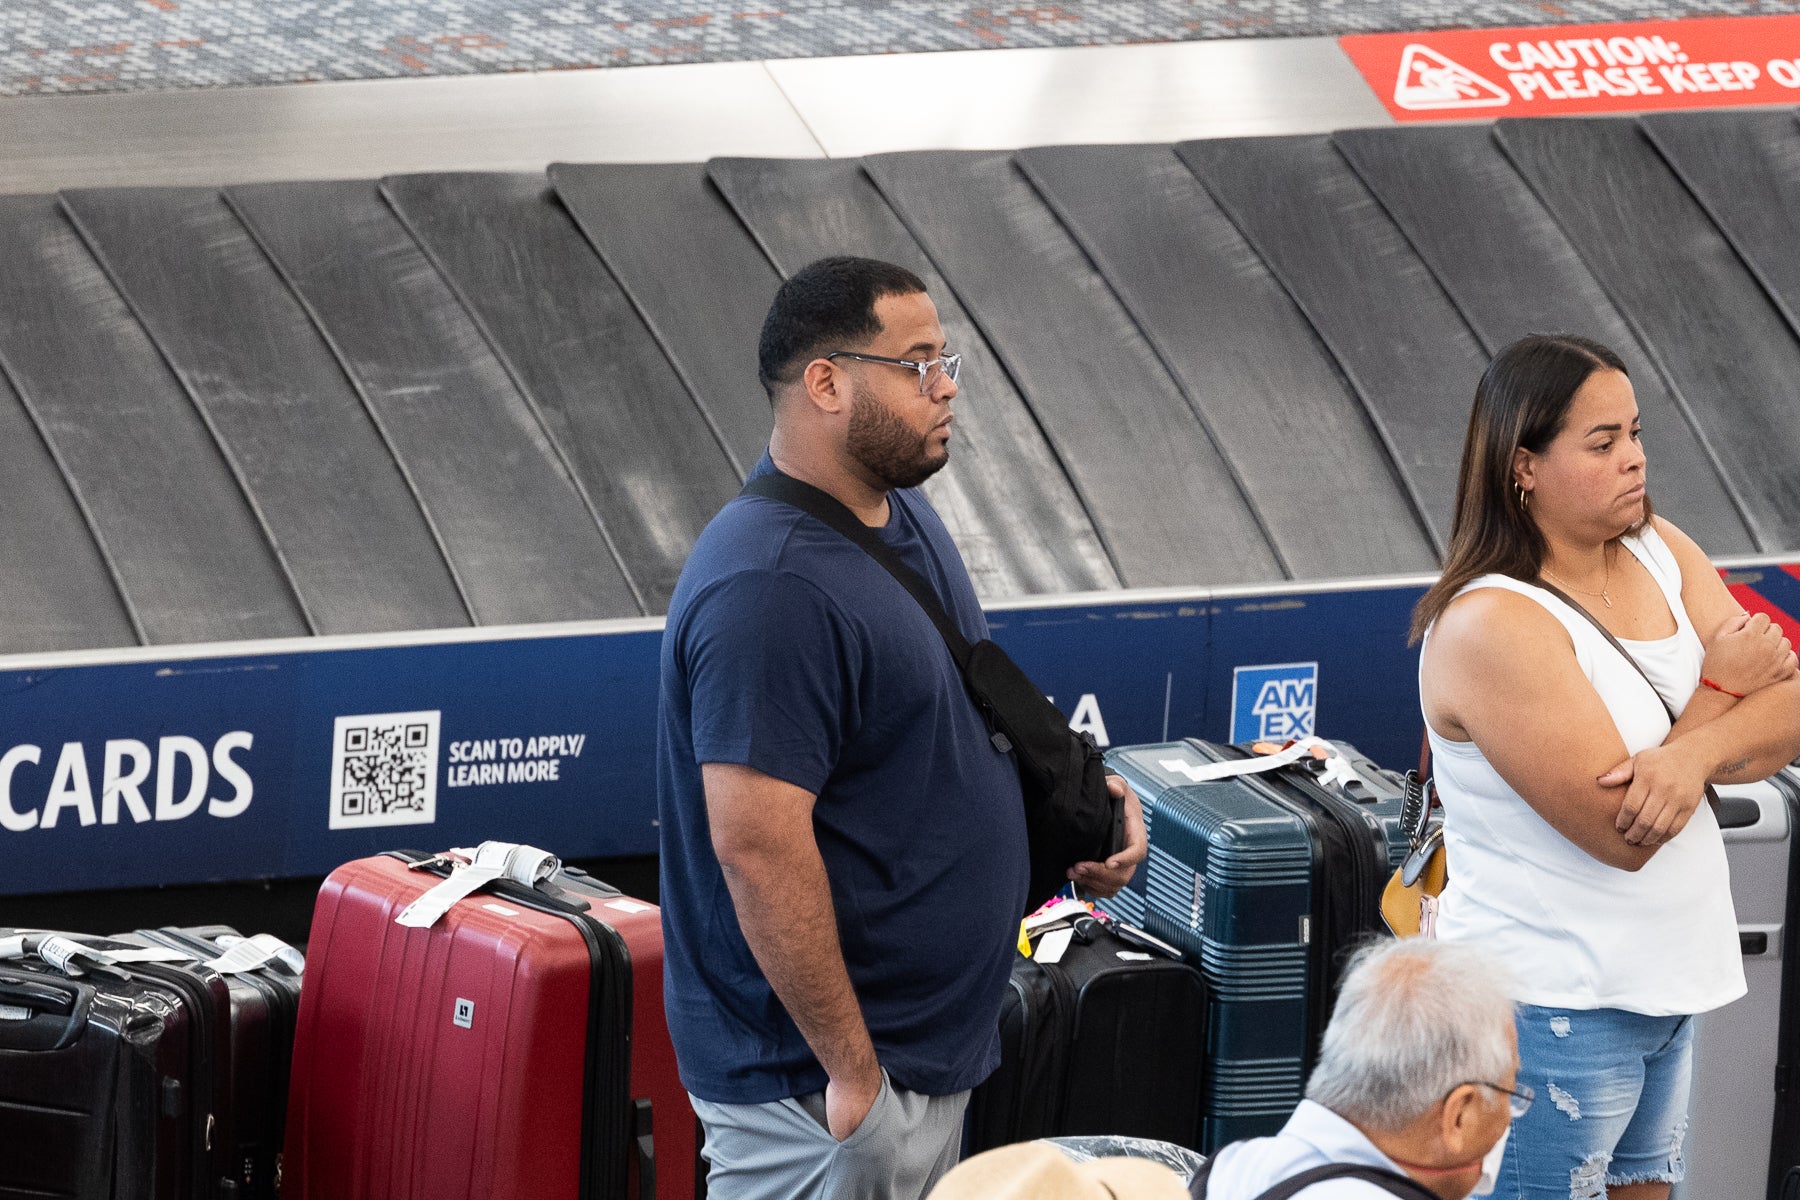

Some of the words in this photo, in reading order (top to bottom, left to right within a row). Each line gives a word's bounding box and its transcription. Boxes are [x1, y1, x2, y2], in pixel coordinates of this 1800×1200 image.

[1489, 35, 1688, 70] CAUTION:
[1508, 67, 1663, 100] PLEASE
[1659, 61, 1760, 93] KEEP
[1251, 678, 1314, 715] AM
[449, 739, 497, 763] SCAN
[499, 738, 523, 760] TO
[525, 734, 586, 758] APPLY/
[0, 731, 253, 831] CARDS
[448, 763, 505, 787] LEARN
[507, 759, 560, 783] MORE
